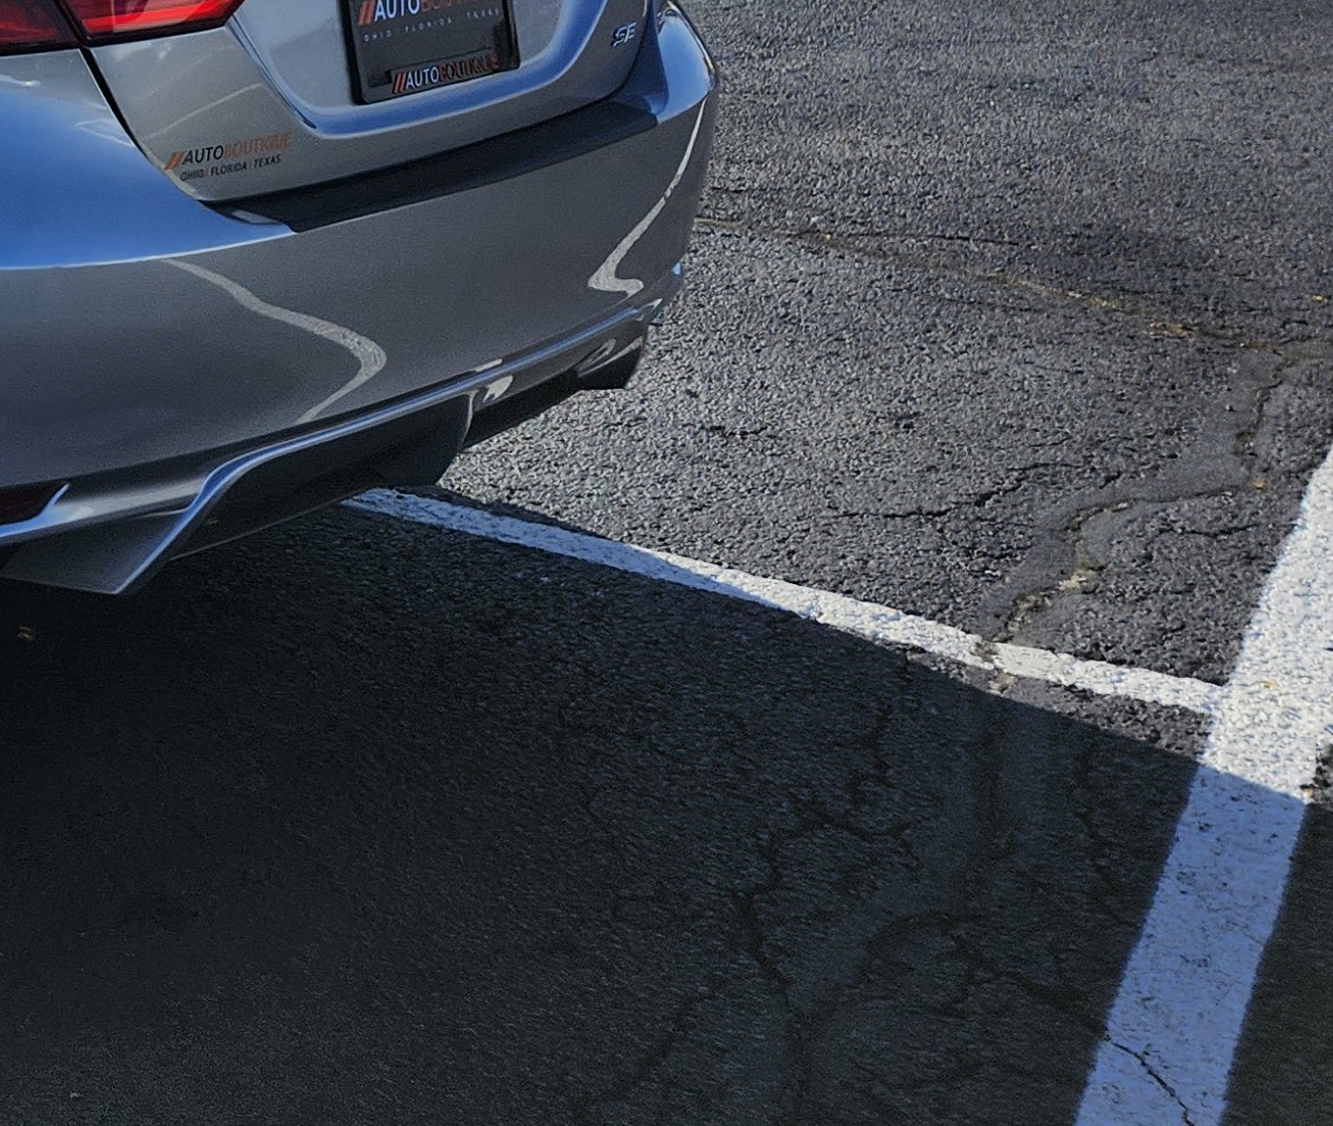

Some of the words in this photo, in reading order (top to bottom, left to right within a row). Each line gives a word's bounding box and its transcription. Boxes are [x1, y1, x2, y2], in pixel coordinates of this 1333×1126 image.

[611, 22, 637, 47] SE
[210, 161, 247, 177] FLORIDA
[253, 154, 282, 168] TEXAS
